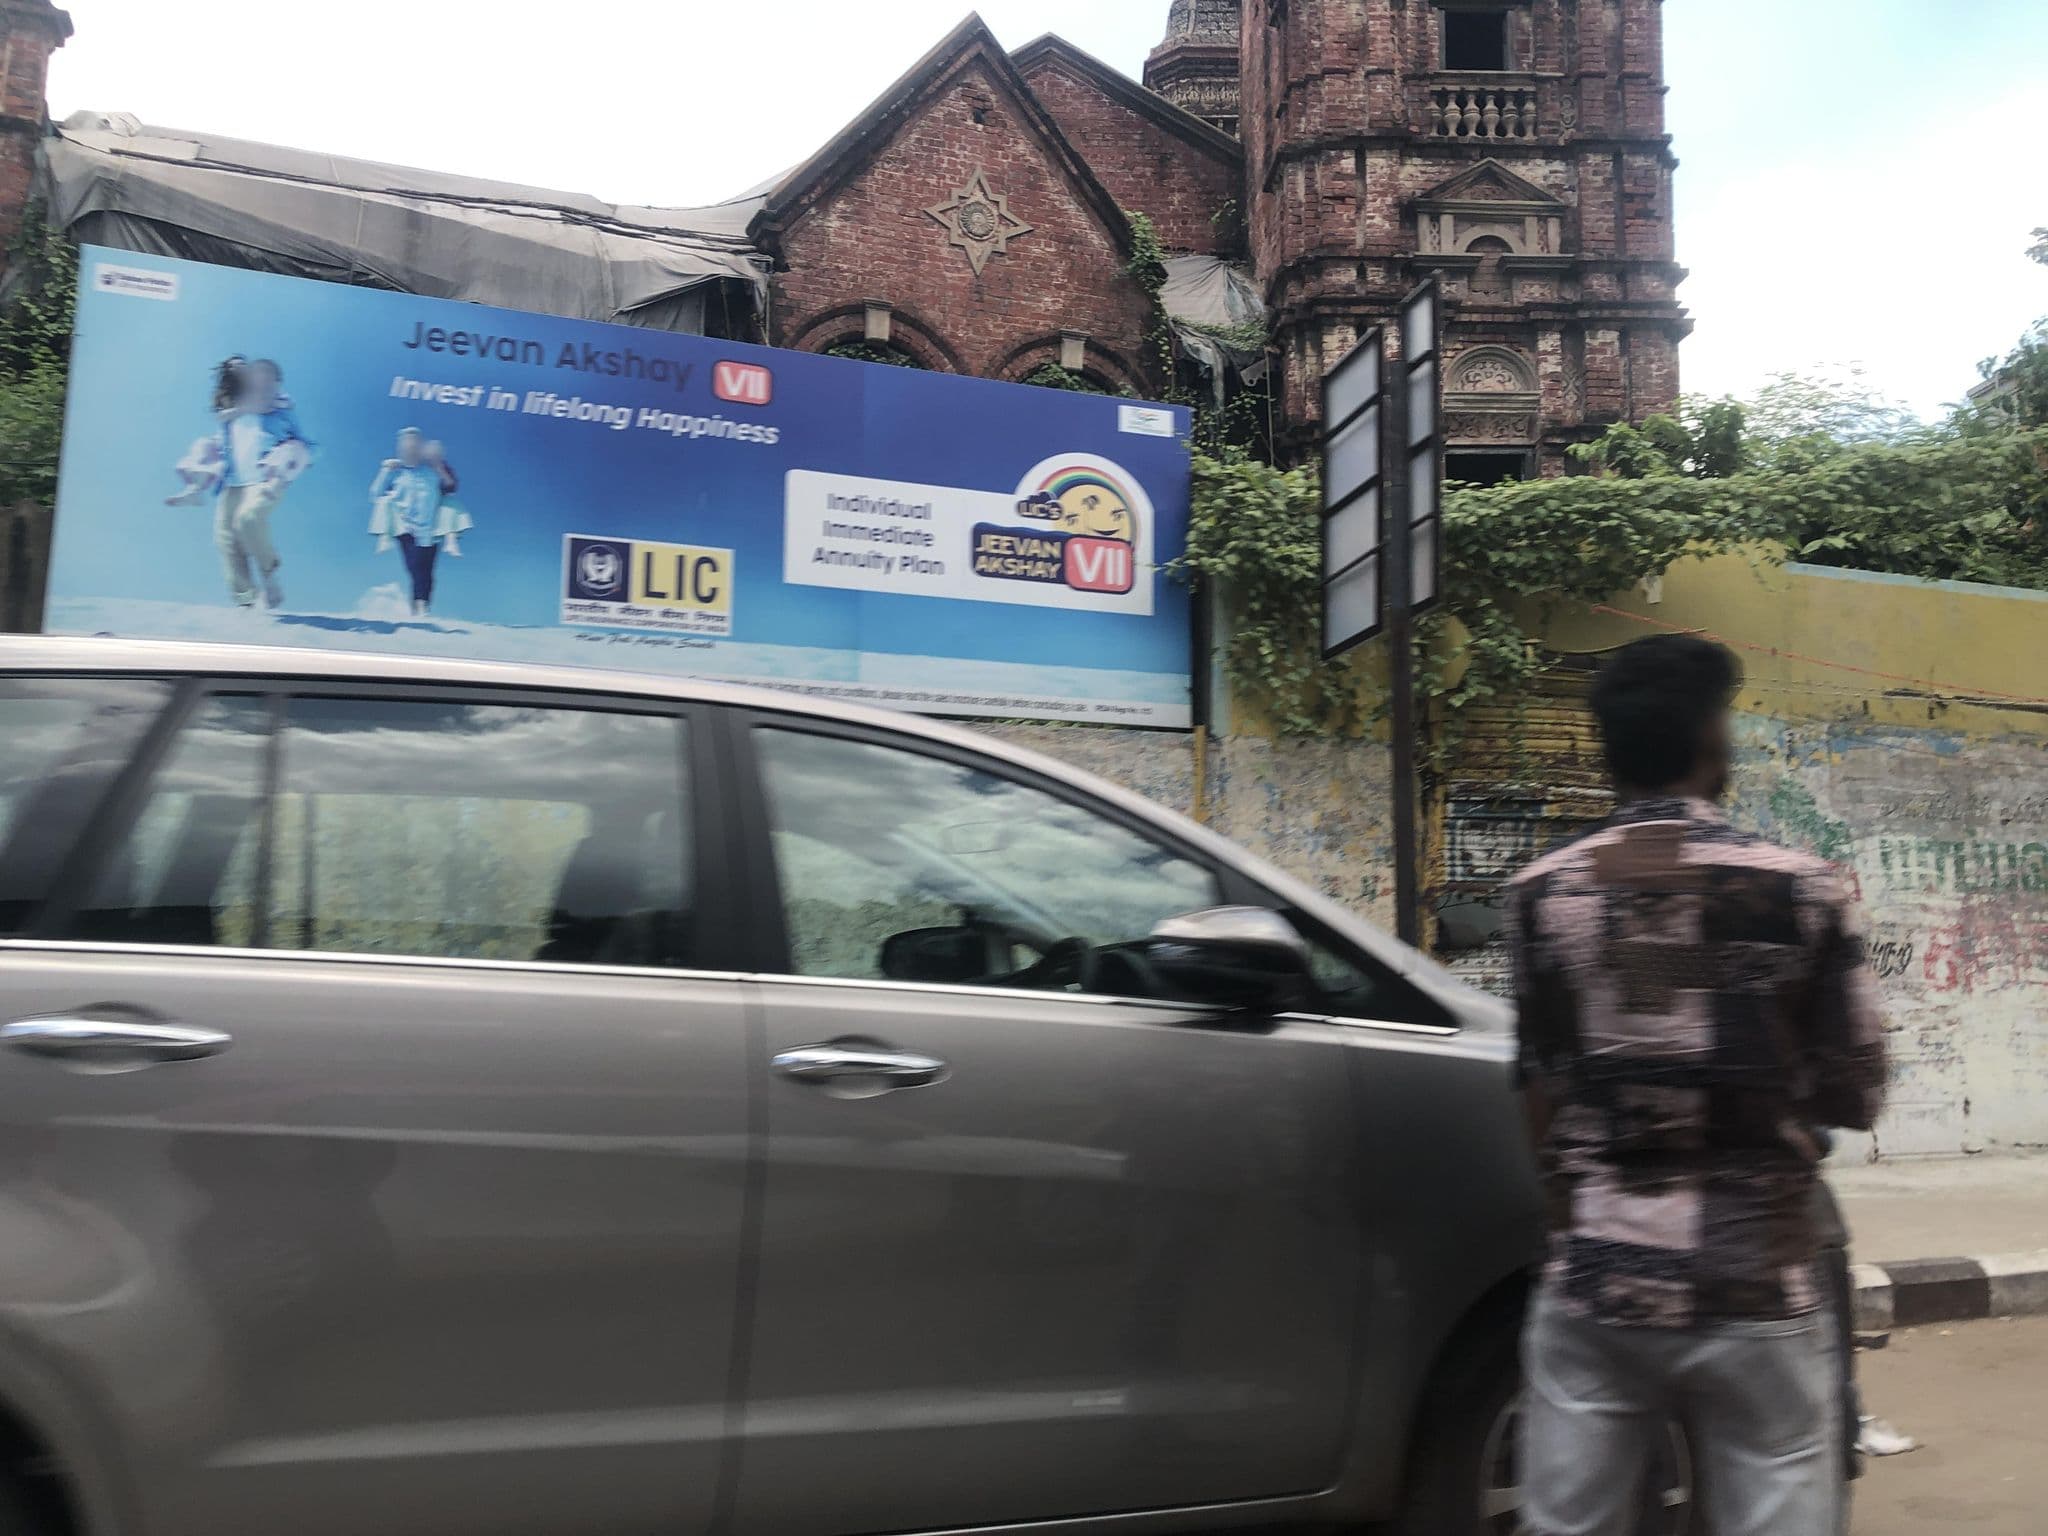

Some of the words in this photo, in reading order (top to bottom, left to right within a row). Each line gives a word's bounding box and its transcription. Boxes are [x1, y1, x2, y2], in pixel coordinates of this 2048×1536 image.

[403, 321, 545, 366] Jeevan
[555, 341, 693, 392] Akshay
[718, 366, 768, 400] VII
[389, 376, 484, 407] Invest
[486, 386, 518, 411] in
[522, 391, 632, 430] lifelong
[636, 407, 780, 445] Happiness
[827, 493, 932, 521] Individual
[822, 520, 934, 547] Immediate
[976, 533, 1062, 559] JEEVAN
[812, 547, 896, 575] Annuity
[899, 555, 945, 575] Plan
[975, 555, 1062, 579] AKSHAY
[1071, 543, 1127, 586] VII
[644, 551, 719, 604] LIC
